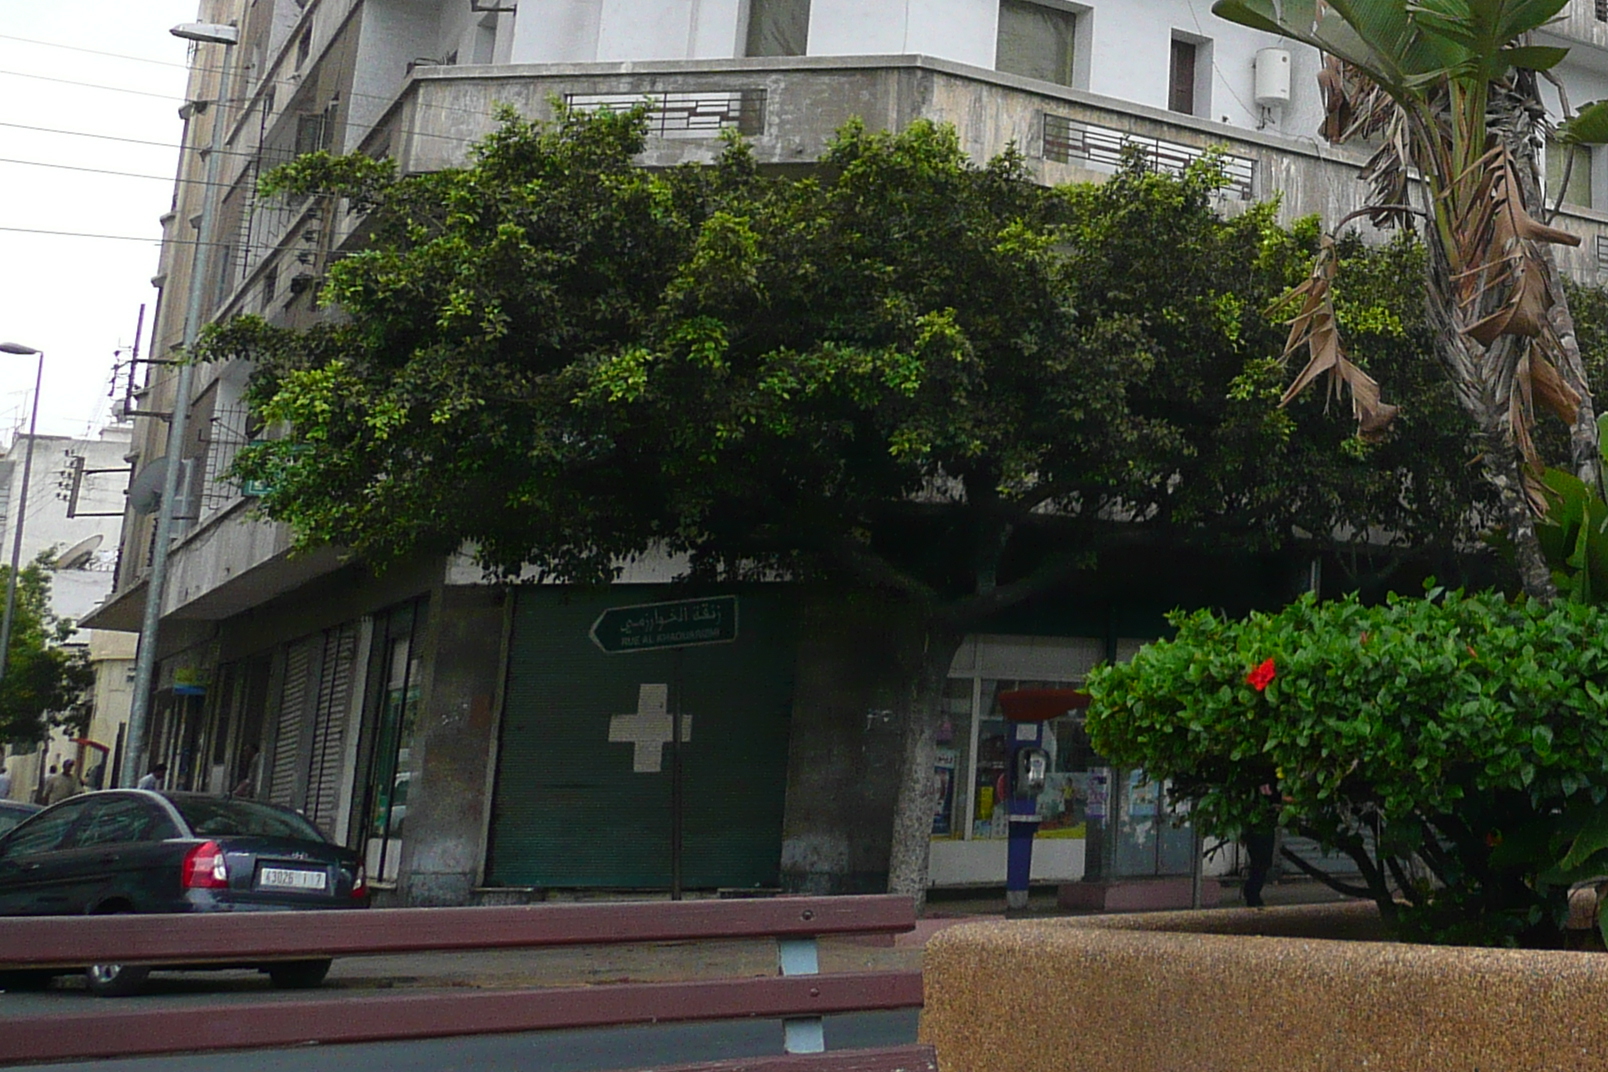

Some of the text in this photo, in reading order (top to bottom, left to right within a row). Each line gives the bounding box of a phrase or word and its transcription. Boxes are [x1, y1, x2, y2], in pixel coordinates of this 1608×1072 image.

[620, 602, 722, 634] زنقة الخوارزمي
[621, 635, 640, 647] RUE
[642, 634, 654, 644] AL
[266, 870, 294, 885] 43026
